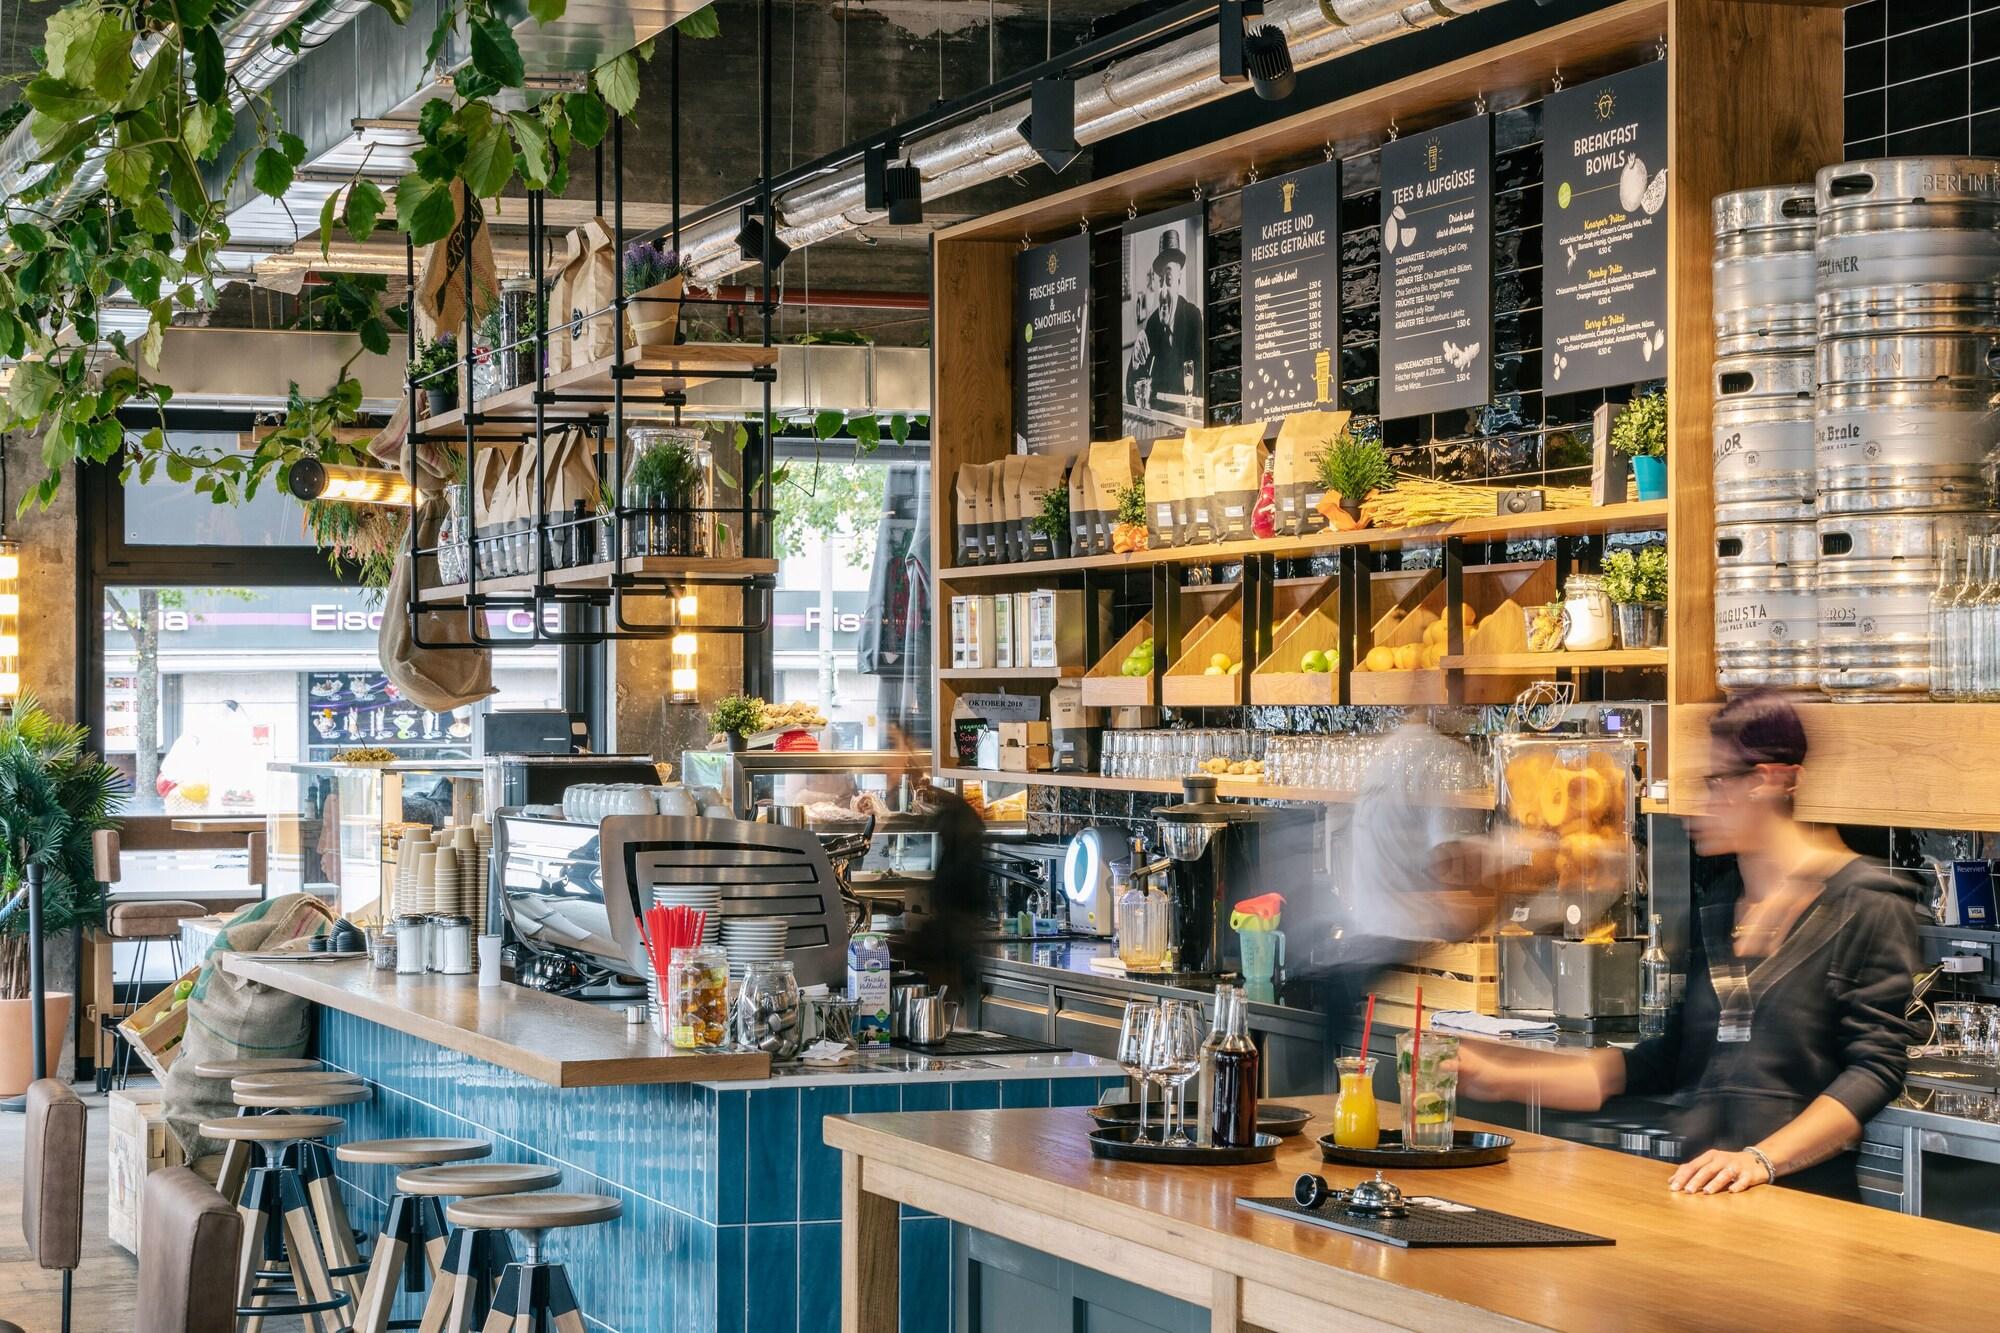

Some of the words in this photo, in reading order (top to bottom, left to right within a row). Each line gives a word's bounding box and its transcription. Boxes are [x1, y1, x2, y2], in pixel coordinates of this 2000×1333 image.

[1574, 123, 1638, 156] BREAKFAST
[1586, 150, 1625, 176] BOWLS
[1392, 186, 1413, 205] TEES
[1417, 184, 1423, 198] &
[1426, 169, 1475, 196] AUFGÜSSE
[1449, 212, 1463, 223] Drink
[1464, 209, 1474, 219] and
[1263, 219, 1292, 240] KAFFEE
[1295, 214, 1313, 231] UND
[1436, 229, 1448, 238] start
[1560, 235, 1583, 245] Griechischer
[1617, 223, 1633, 231] Granola
[1607, 235, 1622, 244] Quinoa
[1252, 242, 1278, 262] HEISSE
[1281, 231, 1325, 255] GETRÄNKE
[1448, 245, 1456, 253] Earl
[1396, 267, 1408, 276] Sweet
[1409, 264, 1423, 273] Orange
[1255, 275, 1270, 288] Made
[1271, 272, 1283, 284] with
[1284, 268, 1297, 281] Love!
[1396, 276, 1413, 286] GRÜNER
[1434, 269, 1448, 278] Jasmin
[1030, 283, 1055, 300] FRISCHE
[1057, 277, 1076, 294] SÄFTE
[1406, 287, 1420, 295] Sencha
[1429, 278, 1459, 291] Ingwer-Zitrone
[1611, 283, 1634, 293] Kokoschips
[1255, 293, 1271, 301] Espresso
[1396, 297, 1415, 308] FRÜCHTE
[1050, 298, 1055, 311] &
[1265, 311, 1277, 319] Lungo
[1396, 310, 1414, 319] Sunshine
[1415, 307, 1424, 315] Lady
[1396, 318, 1415, 329] KRÄUTER
[1451, 309, 1464, 318] Lakritz
[1035, 310, 1071, 330] SMOOTHIES
[1467, 318, 1470, 326] €
[1584, 319, 1601, 330] Berry
[1602, 316, 1607, 327] &
[1255, 322, 1277, 331] Cappuccino
[1265, 330, 1284, 339] Macchiato
[1637, 331, 1647, 339] Pops
[1255, 341, 1275, 350] Filterkaffee
[1263, 350, 1280, 359] Chocolate
[1395, 357, 1433, 371] HAUSGEMACHTER
[1434, 355, 1442, 363] TEE
[1395, 373, 1411, 381] Frischer
[1411, 370, 1425, 380] Ingwer
[1395, 384, 1408, 392] Frische
[1281, 404, 1293, 412] kommt
[969, 699, 1006, 707] OKTOBER
